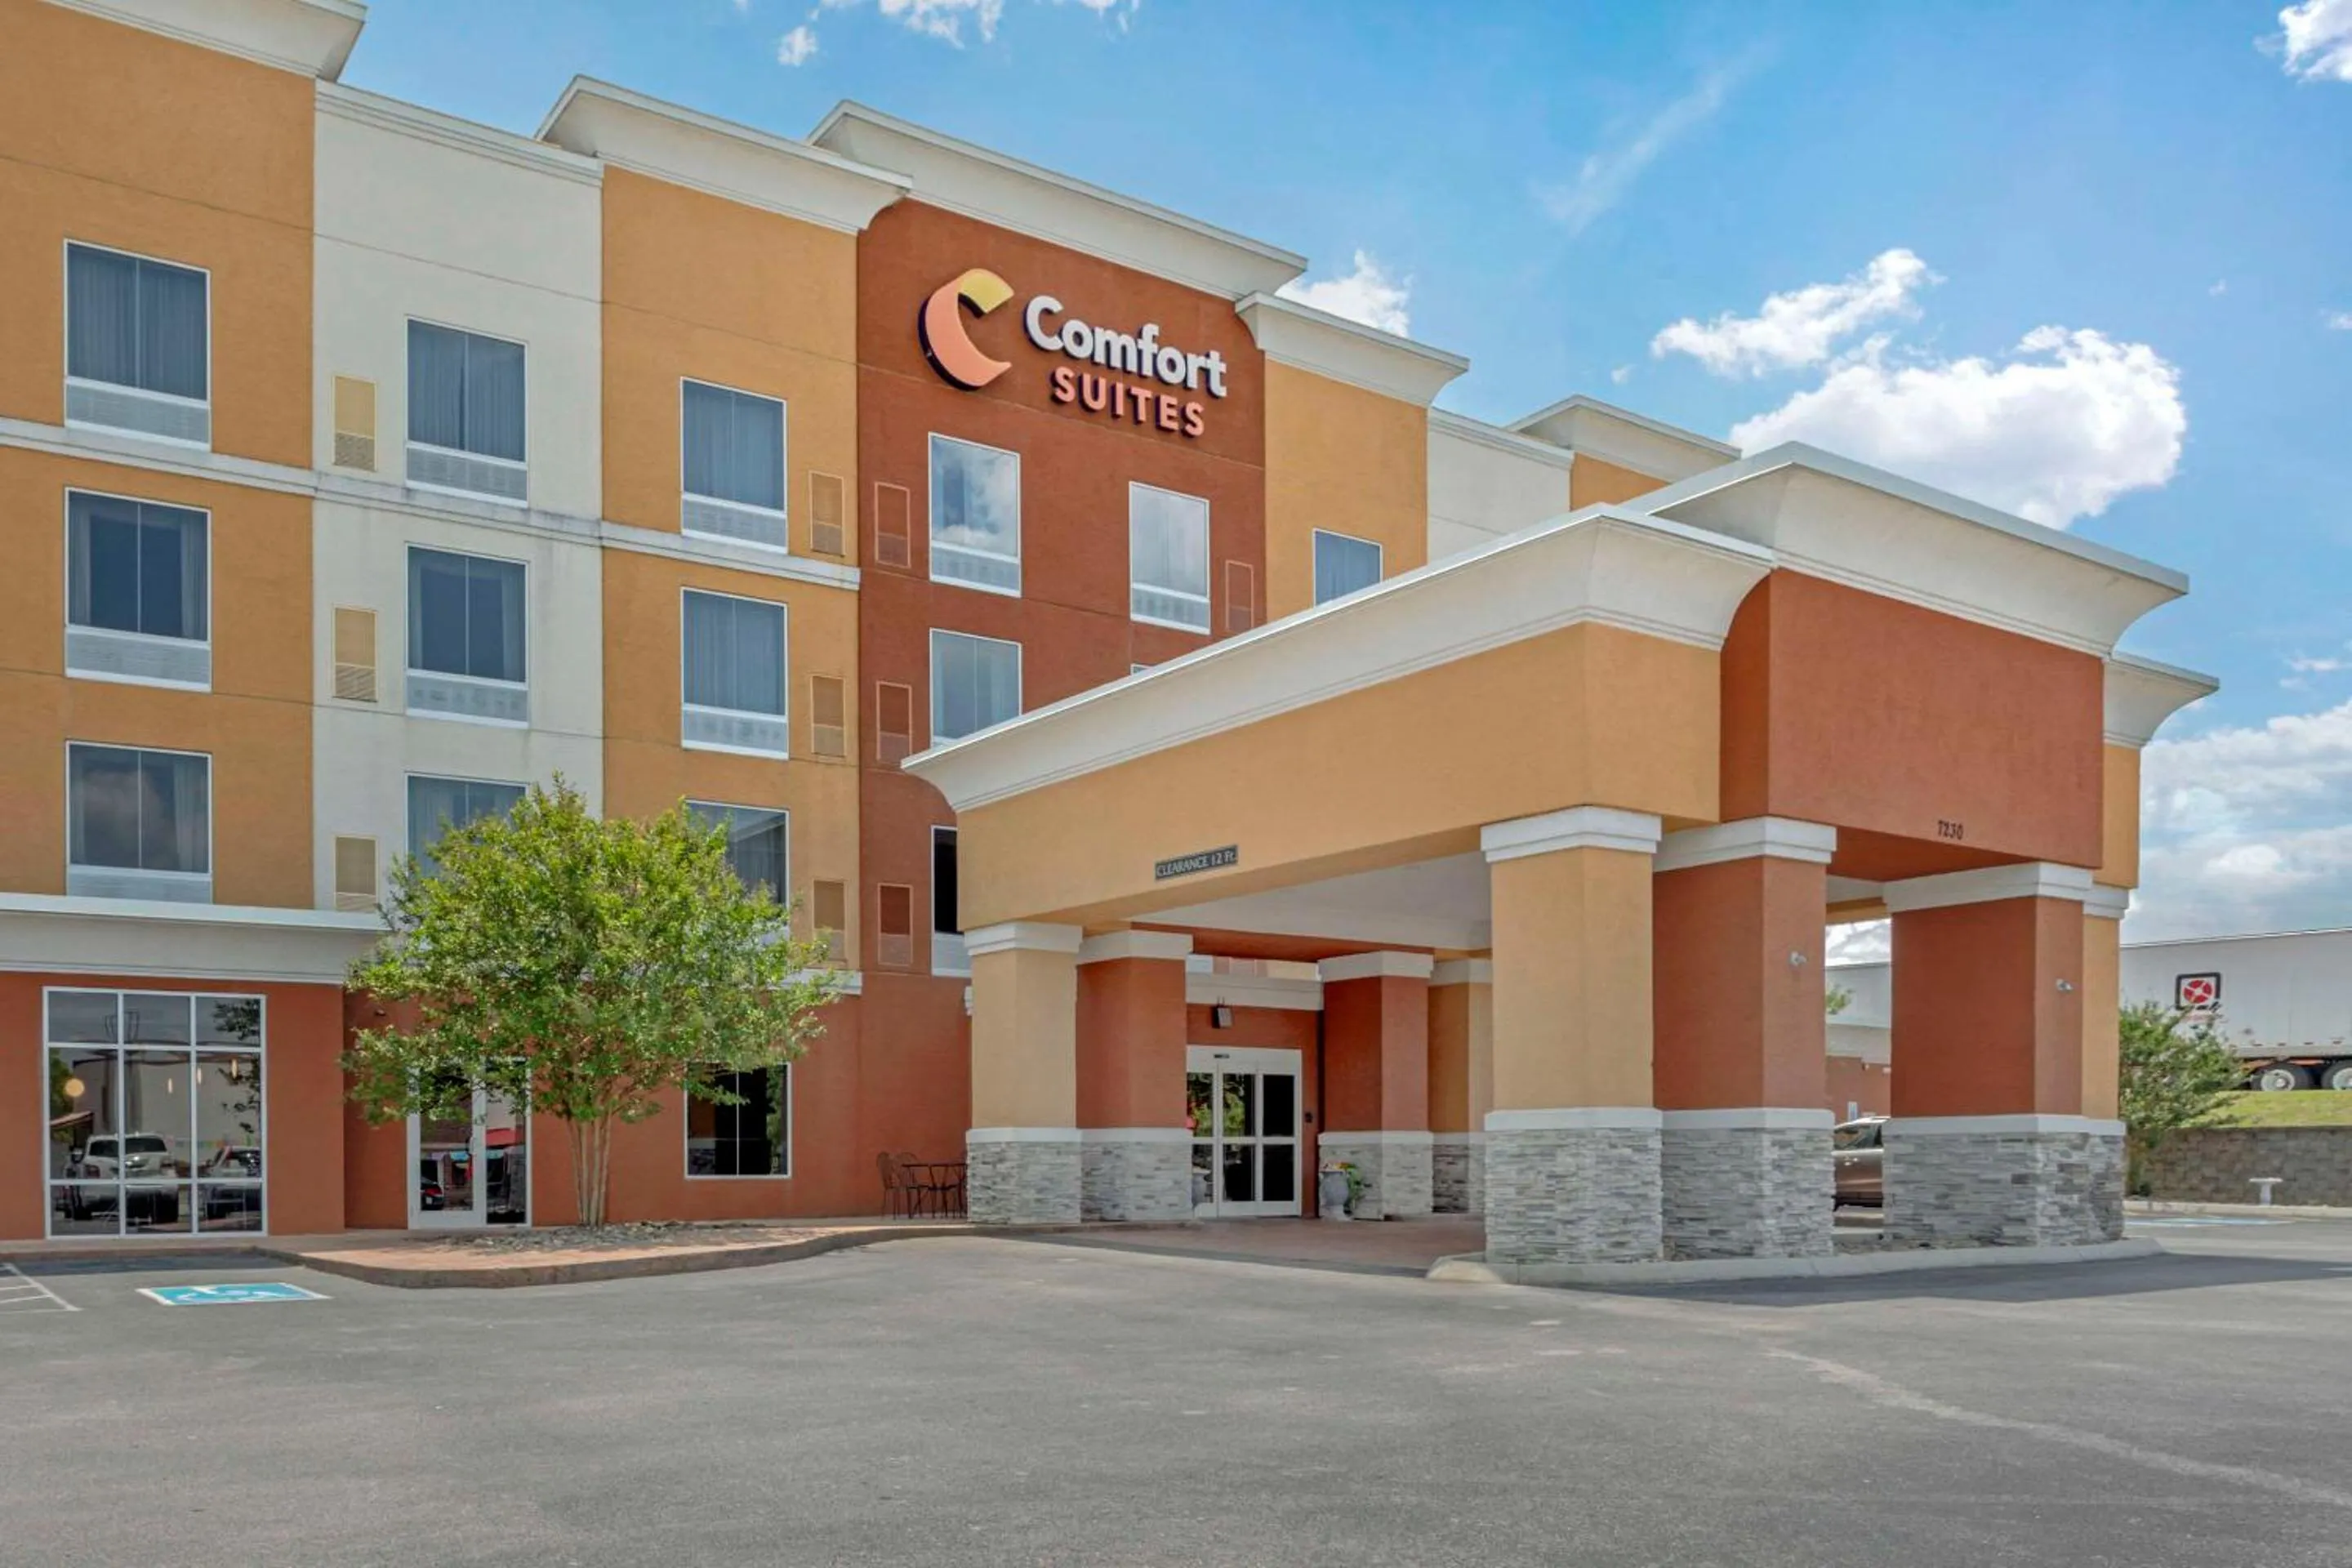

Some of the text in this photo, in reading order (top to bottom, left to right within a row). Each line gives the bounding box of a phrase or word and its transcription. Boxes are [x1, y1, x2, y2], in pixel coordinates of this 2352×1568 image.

[1024, 295, 1227, 398] Comfort
[1051, 366, 1205, 437] SUITES
[1156, 855, 1209, 876] CLEARANCE
[1211, 852, 1223, 866] 12
